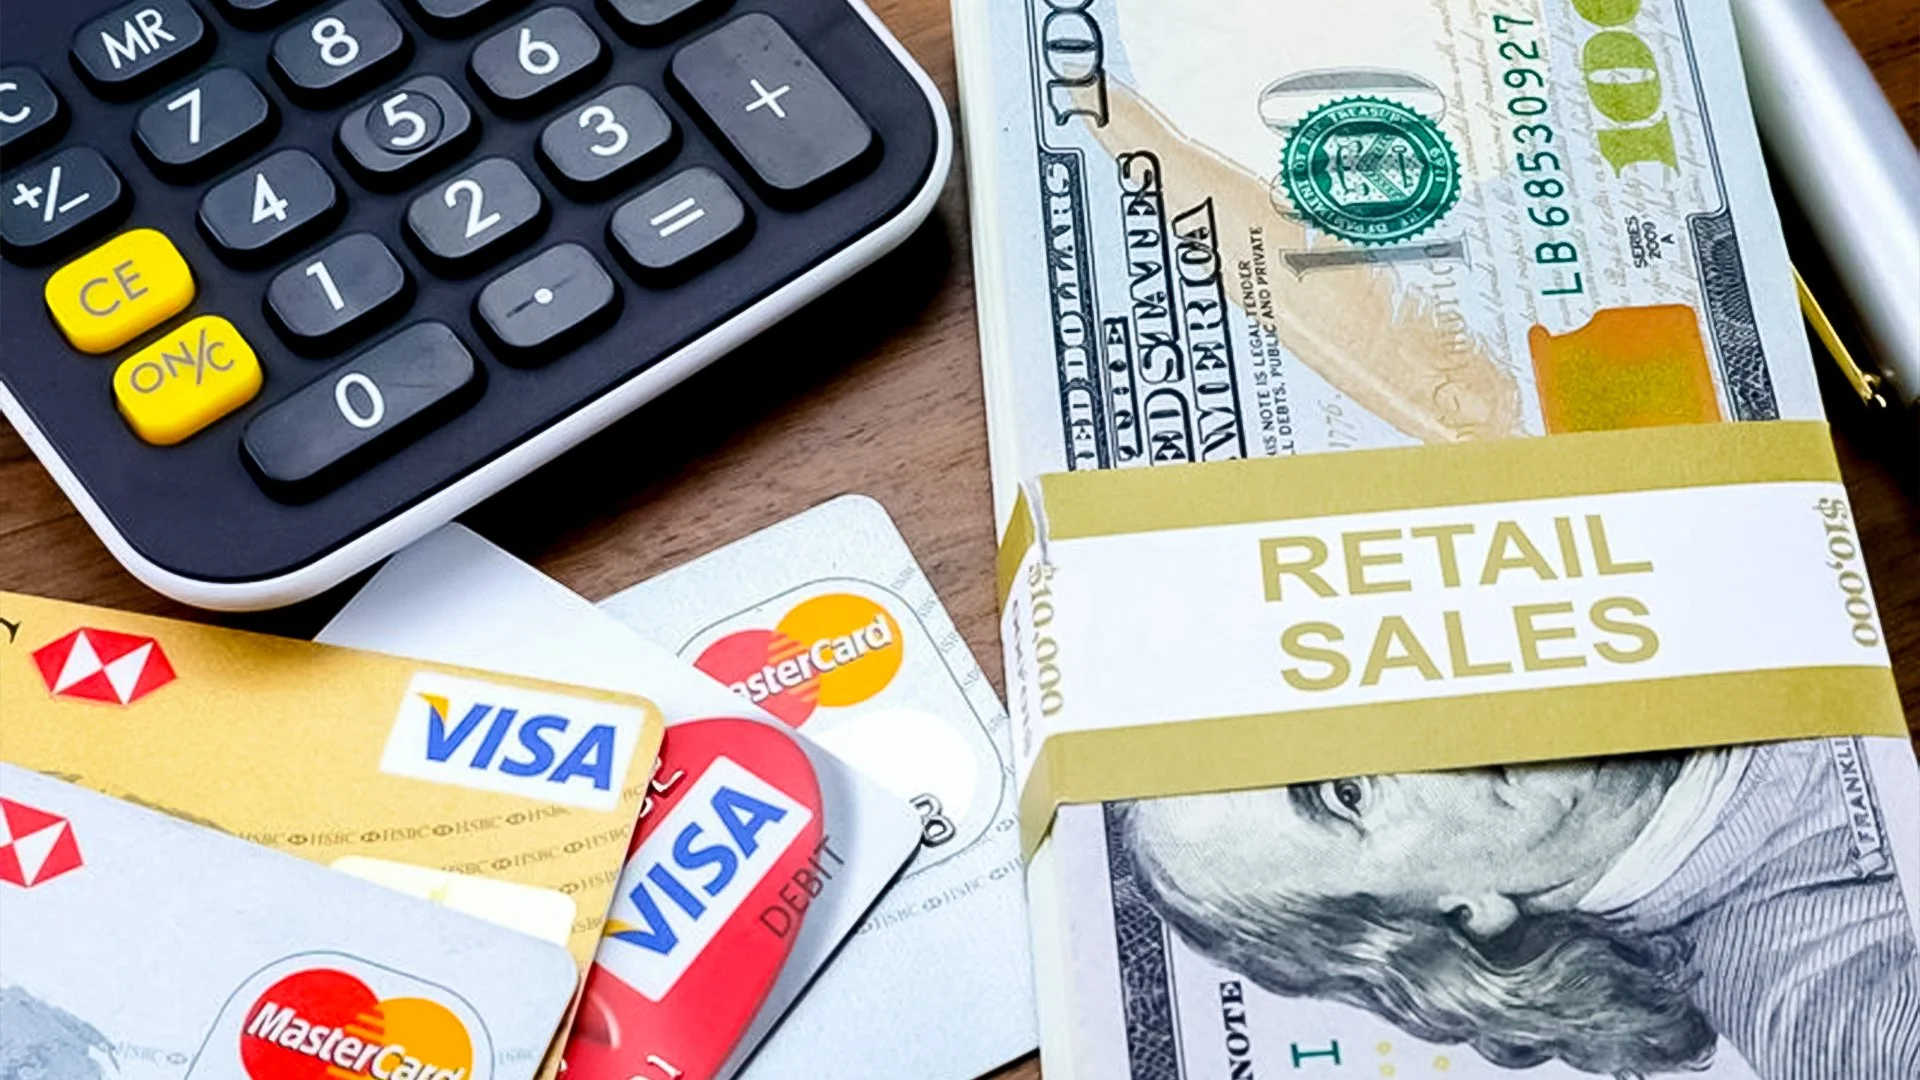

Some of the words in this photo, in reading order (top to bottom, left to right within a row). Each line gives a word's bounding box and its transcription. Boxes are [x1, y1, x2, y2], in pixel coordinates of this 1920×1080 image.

[100, 8, 176, 69] MR
[311, 17, 360, 66] 8
[518, 28, 560, 75] 6
[1042, 0, 1110, 128] 10
[167, 88, 201, 144] 7
[1570, 0, 1681, 178] 10
[382, 93, 427, 147] 5
[578, 105, 630, 156] 3
[251, 173, 289, 224] 4
[444, 179, 501, 238] 2
[1249, 226, 1268, 285] PRIVATE
[1624, 214, 1648, 268] SERIES
[79, 260, 149, 317] CE
[305, 261, 346, 312] 1
[1237, 259, 1257, 318] TENDER
[1257, 288, 1275, 319] AND
[130, 328, 236, 395] ON/C
[1248, 323, 1266, 367] LEGAL
[1263, 323, 1283, 378] PUBLIC
[334, 372, 386, 429] 0
[1255, 369, 1268, 387] IS
[1256, 390, 1274, 432] NOTE
[1259, 513, 1654, 602] RETAIL
[1812, 496, 1880, 649] $10,000
[728, 613, 894, 704] asterCard
[1279, 595, 1660, 692] SALES
[414, 691, 618, 792] VISA
[601, 786, 788, 957] VISA
[759, 835, 845, 940] DEBIT
[1219, 981, 1254, 1080] NOTE
